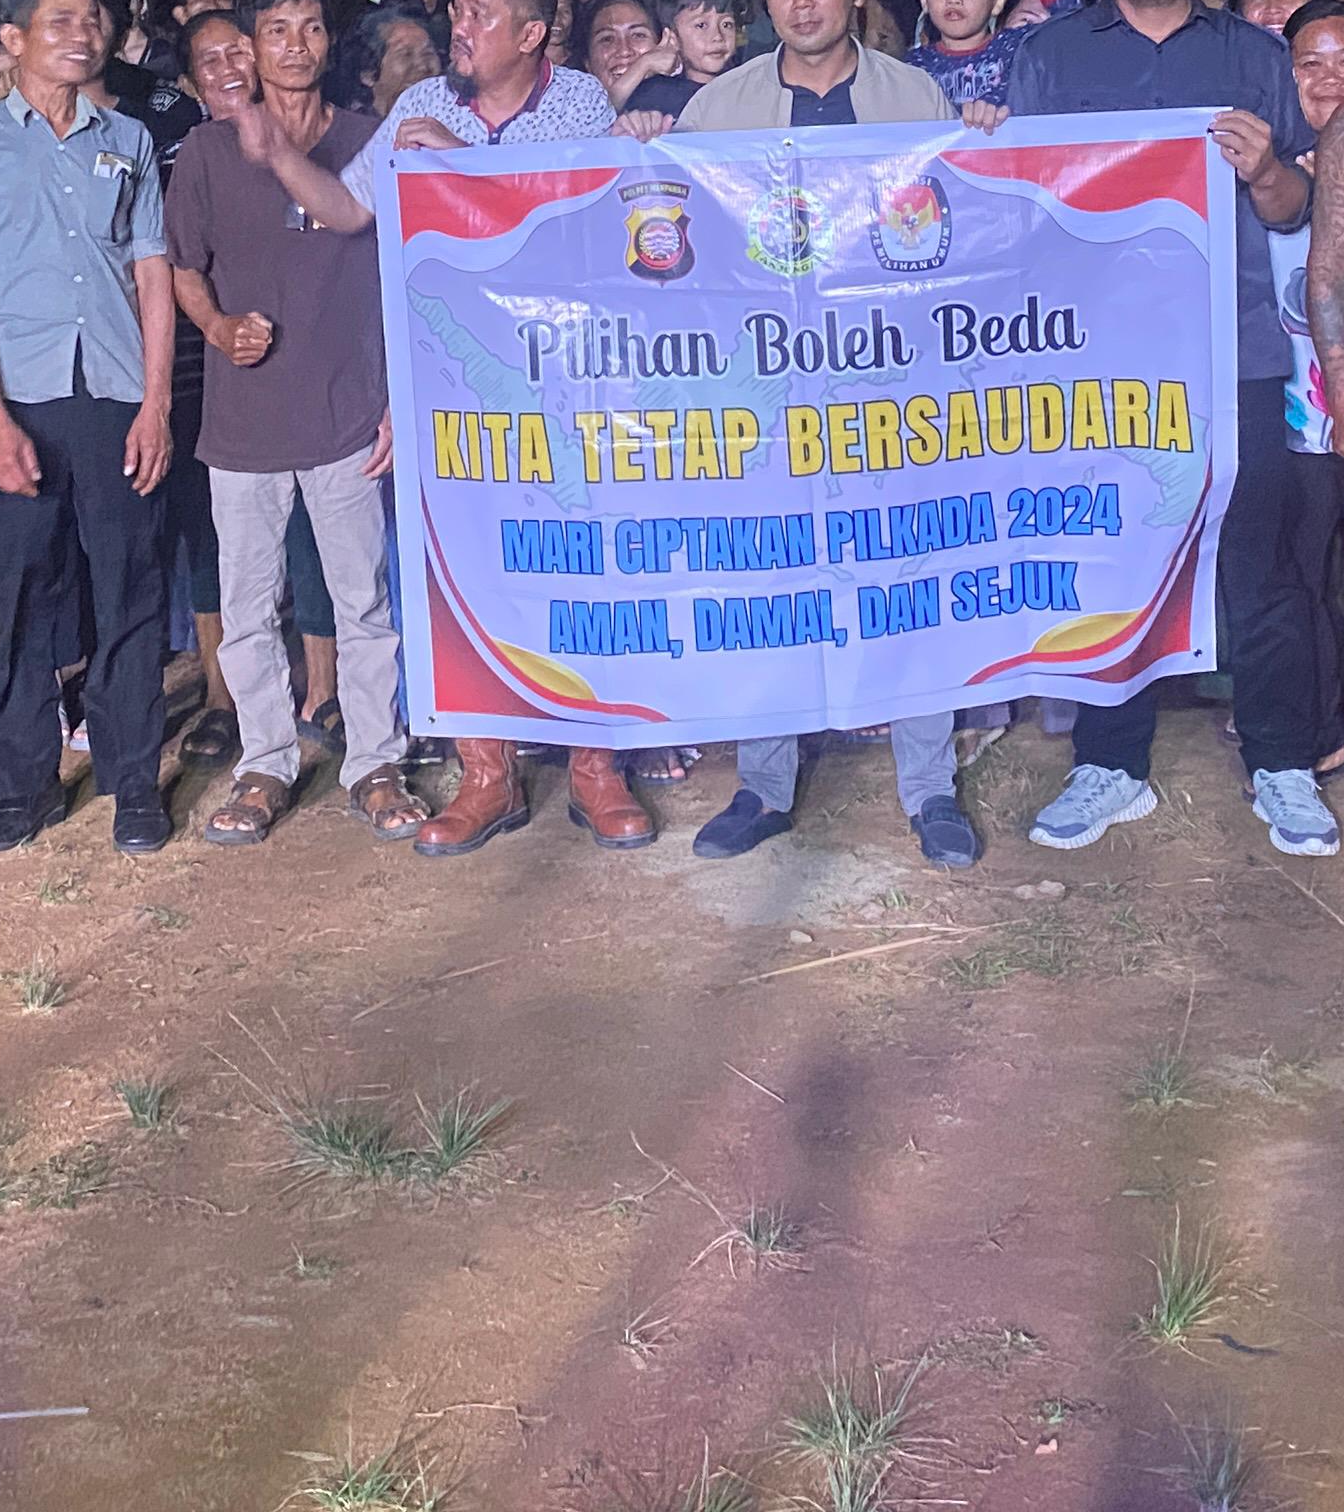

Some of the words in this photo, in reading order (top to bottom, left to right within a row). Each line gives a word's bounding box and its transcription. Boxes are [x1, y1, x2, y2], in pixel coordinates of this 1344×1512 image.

[872, 231, 929, 271] PEMILIHAN
[517, 317, 728, 382] Pilihan
[744, 308, 914, 377] Boleh
[931, 296, 1086, 363] Beda
[432, 409, 554, 483] KITA
[573, 407, 760, 483] TETAP
[785, 378, 1194, 477] BERSAUDARA
[501, 519, 604, 575] MARI
[614, 513, 816, 575] CIPTAKAN
[826, 491, 997, 564] PILKADA
[1007, 483, 1122, 539] 2024
[550, 599, 683, 658] AMAN,
[693, 589, 847, 652] DAMAI,
[857, 577, 941, 639] DAN
[950, 560, 1081, 622] SEJUK
